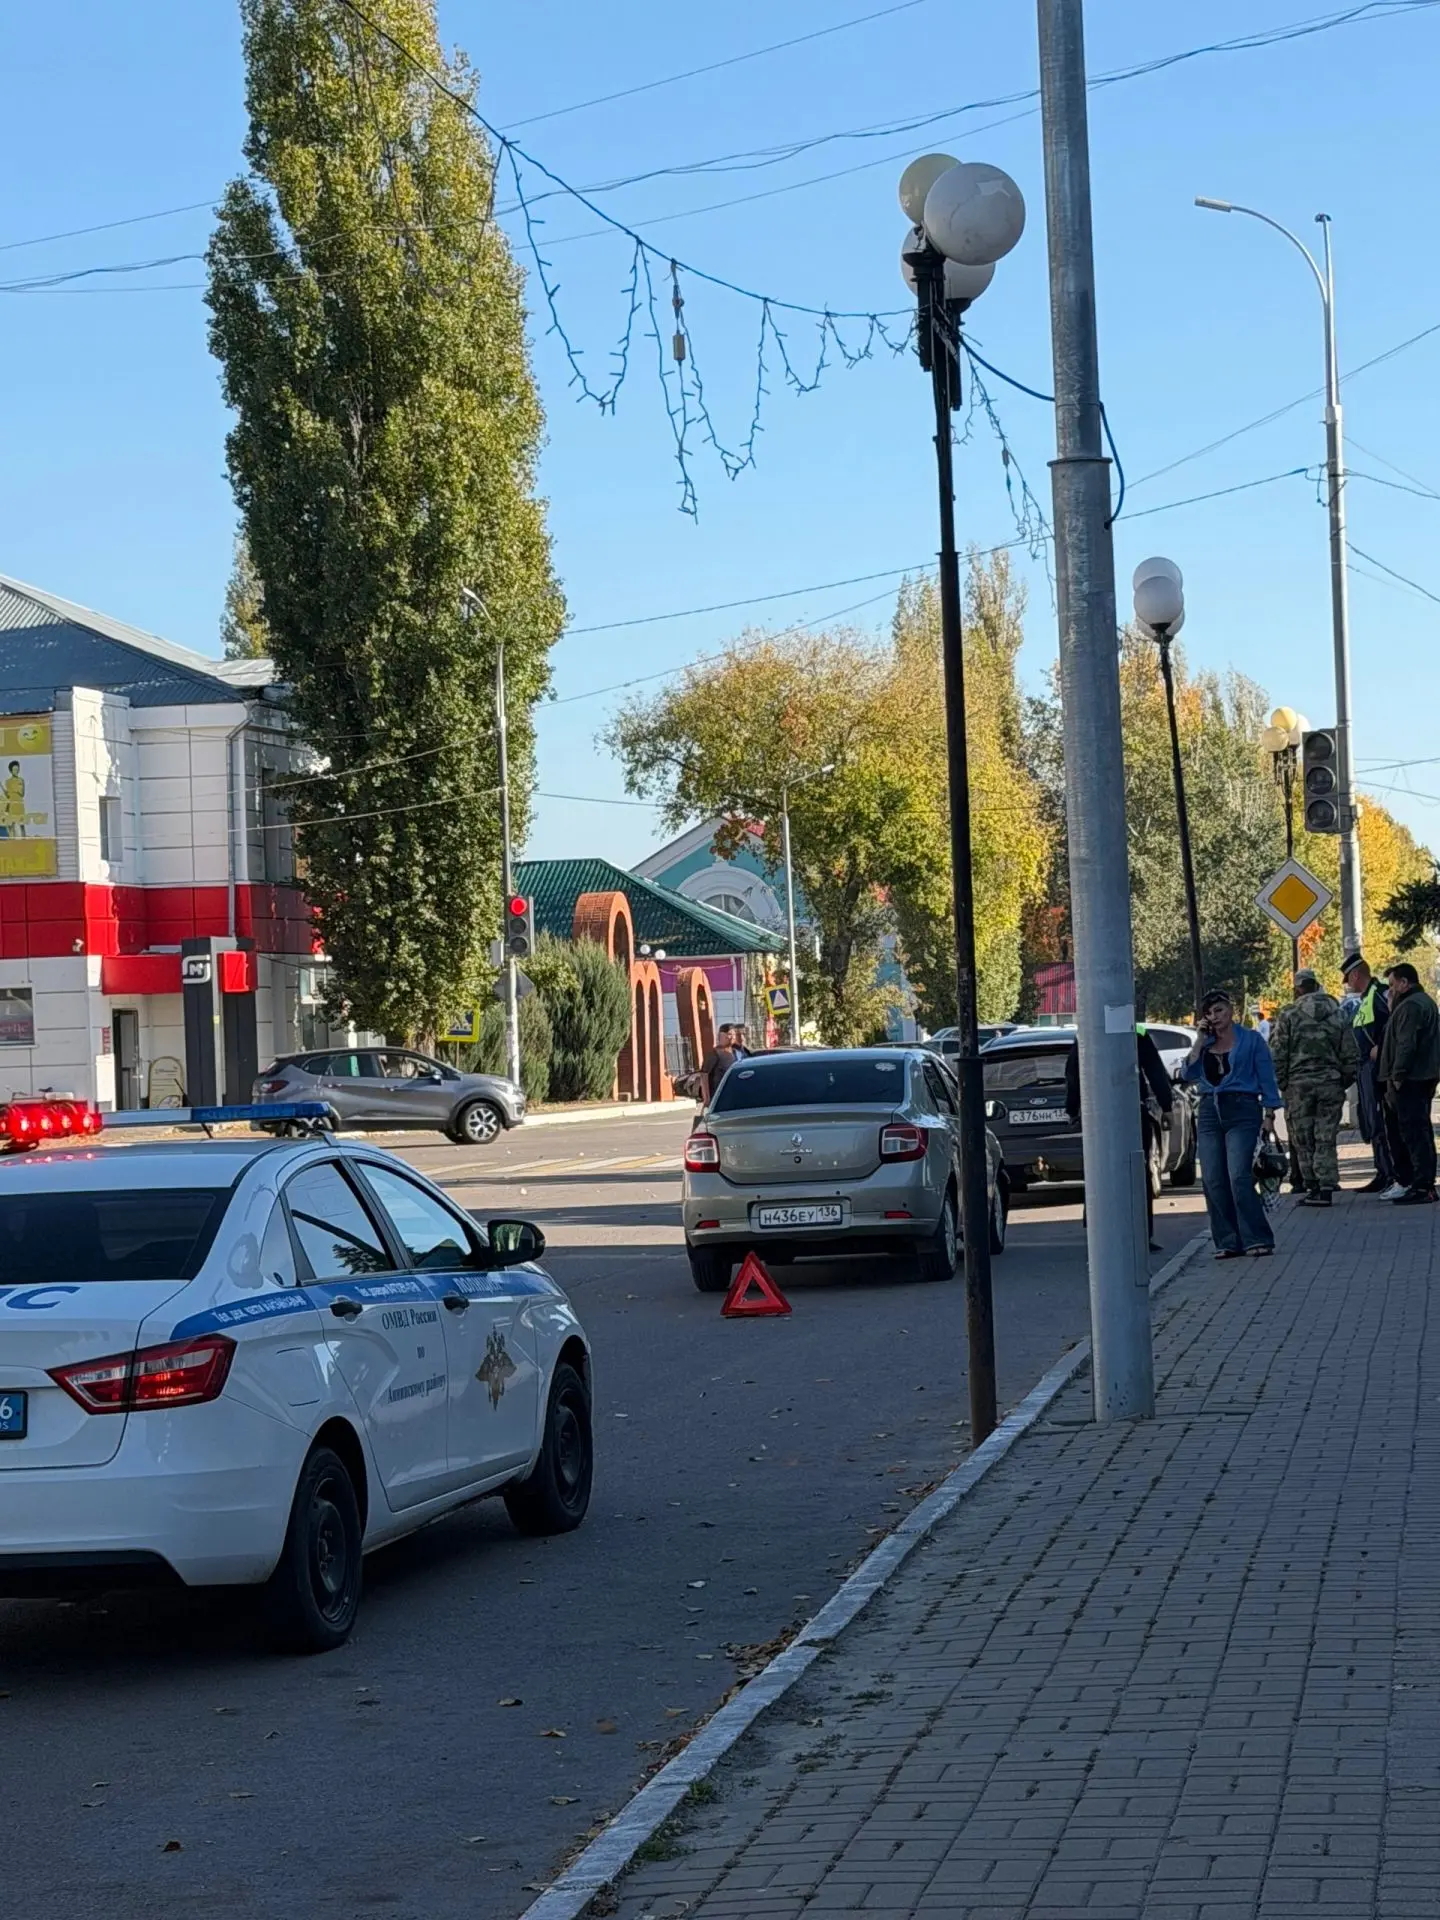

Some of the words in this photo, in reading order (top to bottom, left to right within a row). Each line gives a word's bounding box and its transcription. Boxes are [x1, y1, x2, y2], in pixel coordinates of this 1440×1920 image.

[763, 1209, 815, 1224] Н436ЕУ
[818, 1206, 838, 1217] 136
[381, 1309, 410, 1330] ОМВД
[410, 1308, 439, 1327] России
